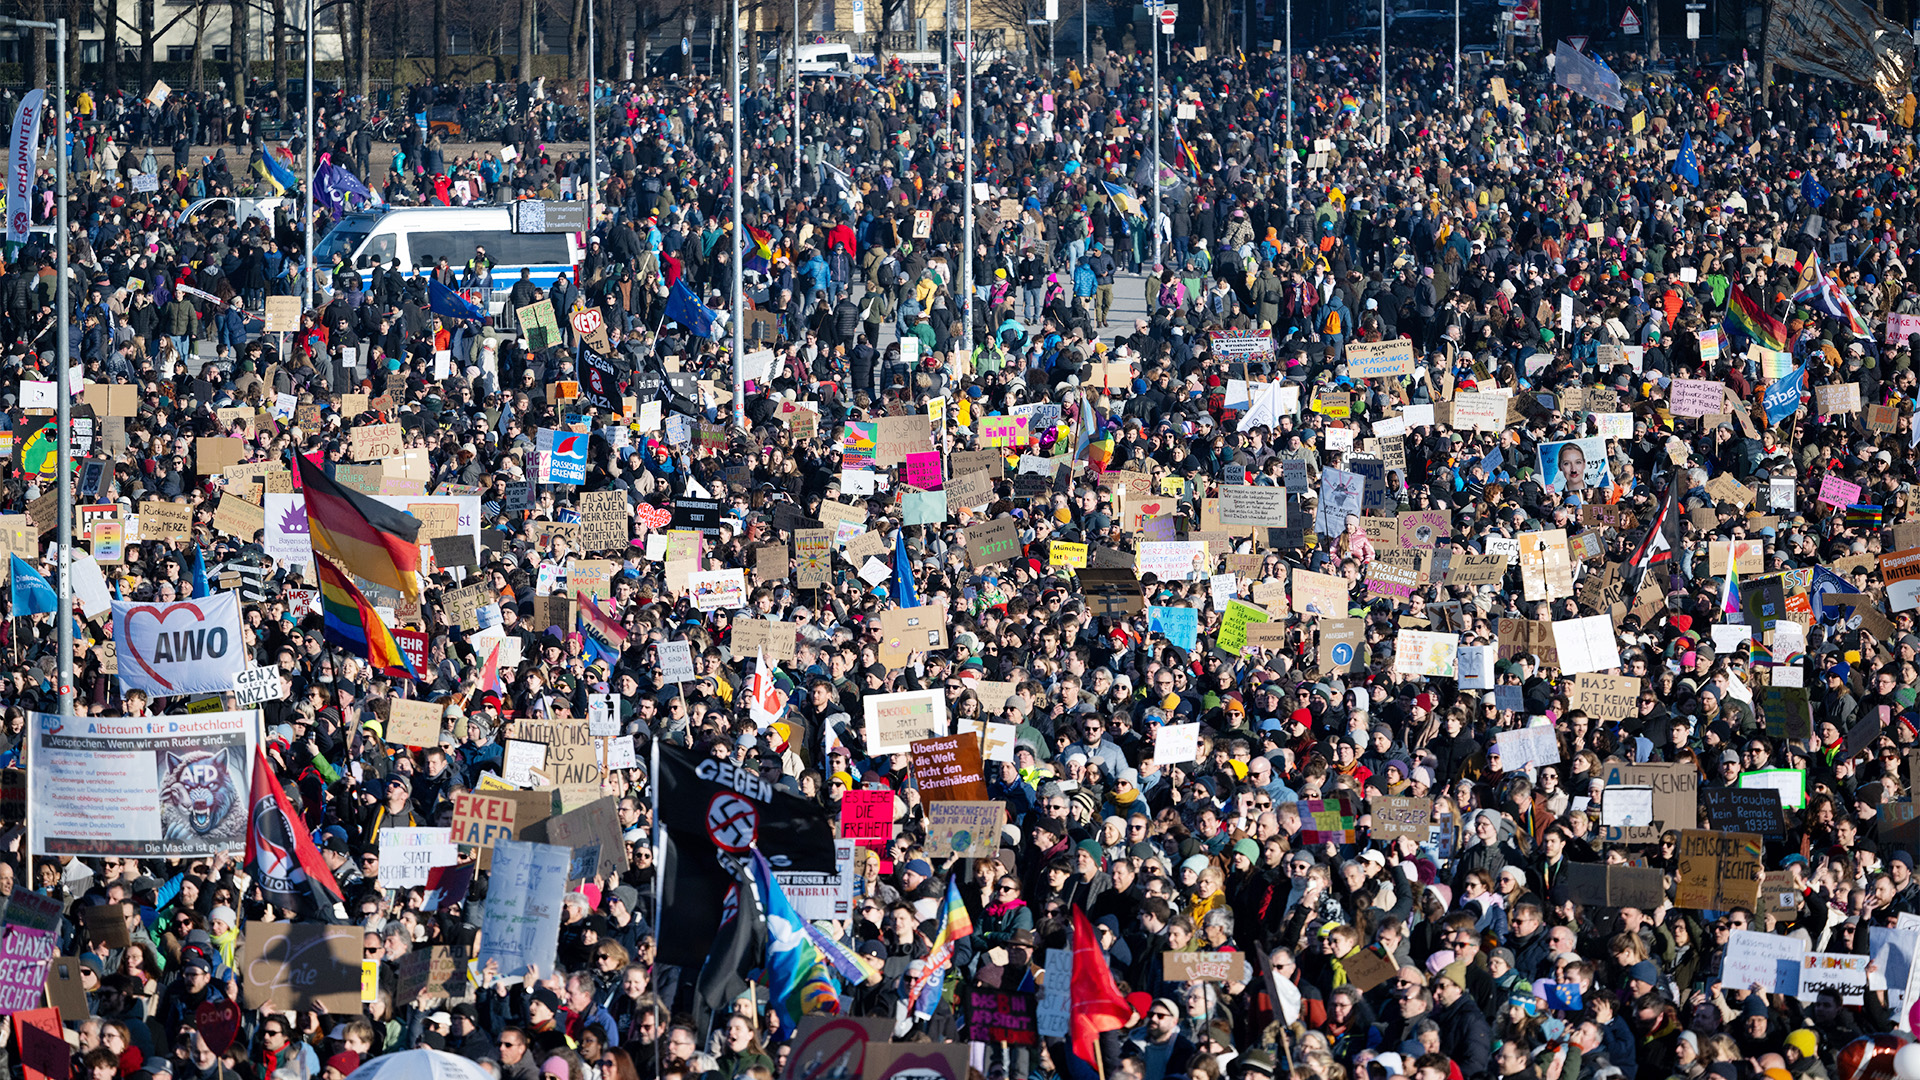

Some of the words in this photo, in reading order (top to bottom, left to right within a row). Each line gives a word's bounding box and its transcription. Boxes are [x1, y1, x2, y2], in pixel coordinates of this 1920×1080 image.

[18, 106, 33, 201] JOHANNITER
[545, 221, 582, 230] Versammlung
[574, 312, 601, 332] HERZ
[1887, 316, 1911, 328] MAKE
[1370, 341, 1412, 352] MEHRHEITEN
[584, 350, 614, 375] GEGEN
[1348, 354, 1409, 367] VERFASSUNGS
[356, 427, 372, 439] Hot
[373, 426, 397, 438] Girls
[884, 421, 902, 434] WIR
[902, 419, 923, 432] SIND
[895, 431, 908, 439] DIE
[369, 444, 390, 457] AFD
[336, 466, 350, 474] ICH
[551, 458, 585, 472] RASSISMUS
[1587, 457, 1606, 470] gegen
[224, 468, 243, 481] Weg
[245, 466, 257, 475] mit
[264, 463, 283, 473] dem
[337, 473, 364, 483] SAUER
[551, 469, 584, 481] ERKENNEN
[585, 491, 605, 502] ALS
[606, 490, 623, 501] WIR
[581, 501, 625, 512] FRAUEN
[676, 499, 718, 510] MENSCHENRECHTE
[143, 504, 189, 522] Rücksichtslos
[581, 512, 602, 522] MEHR
[603, 510, 626, 521] RECHTE
[690, 513, 705, 521] STATT
[421, 519, 445, 530] STATT
[1379, 521, 1395, 530] KURZ
[1403, 513, 1418, 530] SEI
[582, 531, 611, 541] MEINTEN
[611, 530, 626, 540] WIR
[696, 527, 719, 536] MENSCHEN
[969, 532, 983, 541] Nie
[985, 525, 1006, 535] wieder
[582, 540, 602, 550] NICHT
[795, 537, 829, 551] VIELFALT
[849, 533, 876, 549] RACISM
[979, 538, 1014, 556] JETZT!
[1053, 544, 1085, 553] München
[1402, 548, 1427, 558] HALTEN
[285, 555, 307, 564] August
[1064, 553, 1084, 563] bunt!
[1464, 556, 1500, 566] BLAU
[574, 567, 601, 578] HASS
[1171, 570, 1186, 579] HAT
[1212, 575, 1231, 583] KEIN
[1398, 568, 1418, 580] EINER
[1455, 571, 1496, 582] NULLE
[1214, 583, 1234, 592] MERZ
[1366, 578, 1397, 595] NAZIS
[289, 590, 309, 600] HASS
[442, 595, 452, 605] ES
[452, 591, 463, 602] IST
[463, 586, 477, 600] NICHT
[453, 602, 461, 613] 5
[463, 600, 473, 608] VOR
[477, 594, 487, 606] 12
[450, 613, 461, 624] ES
[462, 609, 474, 620] IST
[1512, 621, 1547, 643] AFD
[153, 626, 228, 664] AWO
[1400, 646, 1424, 654] BRAND
[237, 669, 266, 684] GEN
[267, 666, 277, 680] X
[1581, 677, 1617, 691] HASS
[235, 682, 279, 705] NAZIS
[1580, 692, 1600, 704] IST
[1603, 693, 1635, 705] KEINE
[191, 702, 220, 714] München
[1579, 703, 1638, 720] MEINUNG
[88, 722, 144, 737] Albtraum
[147, 721, 165, 734] für
[169, 717, 244, 732] Deutschland
[897, 718, 917, 728] STATT
[107, 738, 135, 750] Wenn
[136, 738, 153, 748] wir
[154, 739, 170, 748] am
[171, 736, 201, 749] Ruder
[880, 731, 904, 742] RECHTE
[912, 738, 958, 756] Überlasst
[547, 746, 575, 763] AUS
[915, 756, 931, 768] die
[933, 752, 956, 765] Welt
[180, 764, 218, 784] AFD
[917, 767, 941, 780] nicht
[942, 764, 962, 776] den
[694, 757, 774, 804] GEGEN
[920, 772, 983, 792] Schreihälsen.
[1651, 773, 1697, 794] KENEN
[845, 791, 859, 803] ES
[862, 791, 890, 803] LEBE
[1391, 798, 1410, 807] KEIN
[1708, 792, 1727, 805] Wir
[1730, 793, 1776, 806] brauchen
[455, 794, 514, 824] EKEL
[855, 804, 875, 819] DIE
[930, 803, 1000, 818] MENSCHENRECHTE
[1376, 806, 1428, 825] GLITZER
[1712, 806, 1733, 820] kein
[1737, 806, 1773, 819] Remake
[946, 816, 960, 825] FÜR
[960, 815, 977, 826] ALLE
[980, 815, 997, 827] DA!
[1722, 823, 1740, 834] von
[1744, 819, 1778, 832] 1933!!!
[844, 821, 892, 839] FREIHEIT
[1384, 823, 1399, 833] FÜR
[145, 843, 161, 853] Die
[162, 842, 194, 853] Maske
[195, 841, 207, 852] ist
[1686, 836, 1746, 858] MENSCHEN-
[403, 851, 432, 864] STATT
[380, 865, 410, 880] RECHTE
[777, 876, 791, 885] IST
[792, 875, 823, 885] BESSER
[825, 875, 841, 884] ALS
[1804, 955, 1867, 972] BRANDMAUER
[1185, 962, 1230, 980] LIEBE
[200, 1008, 233, 1024] DEMO
